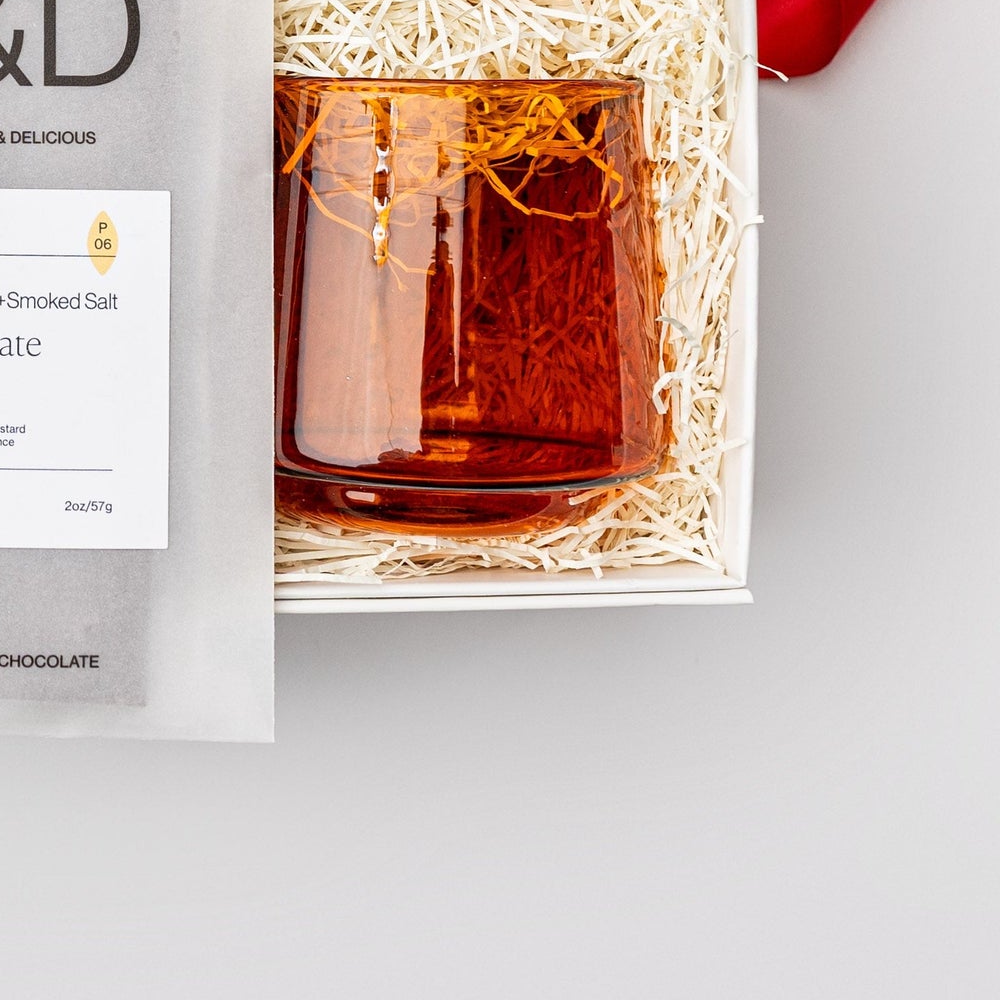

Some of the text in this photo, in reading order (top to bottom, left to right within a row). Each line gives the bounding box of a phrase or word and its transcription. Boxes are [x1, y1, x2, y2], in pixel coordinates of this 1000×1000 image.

[10, 131, 96, 145] DELICIOUS
[98, 222, 108, 234] P
[94, 238, 112, 250] 06
[85, 293, 118, 310] Salt
[64, 500, 112, 514] 2oz/57g
